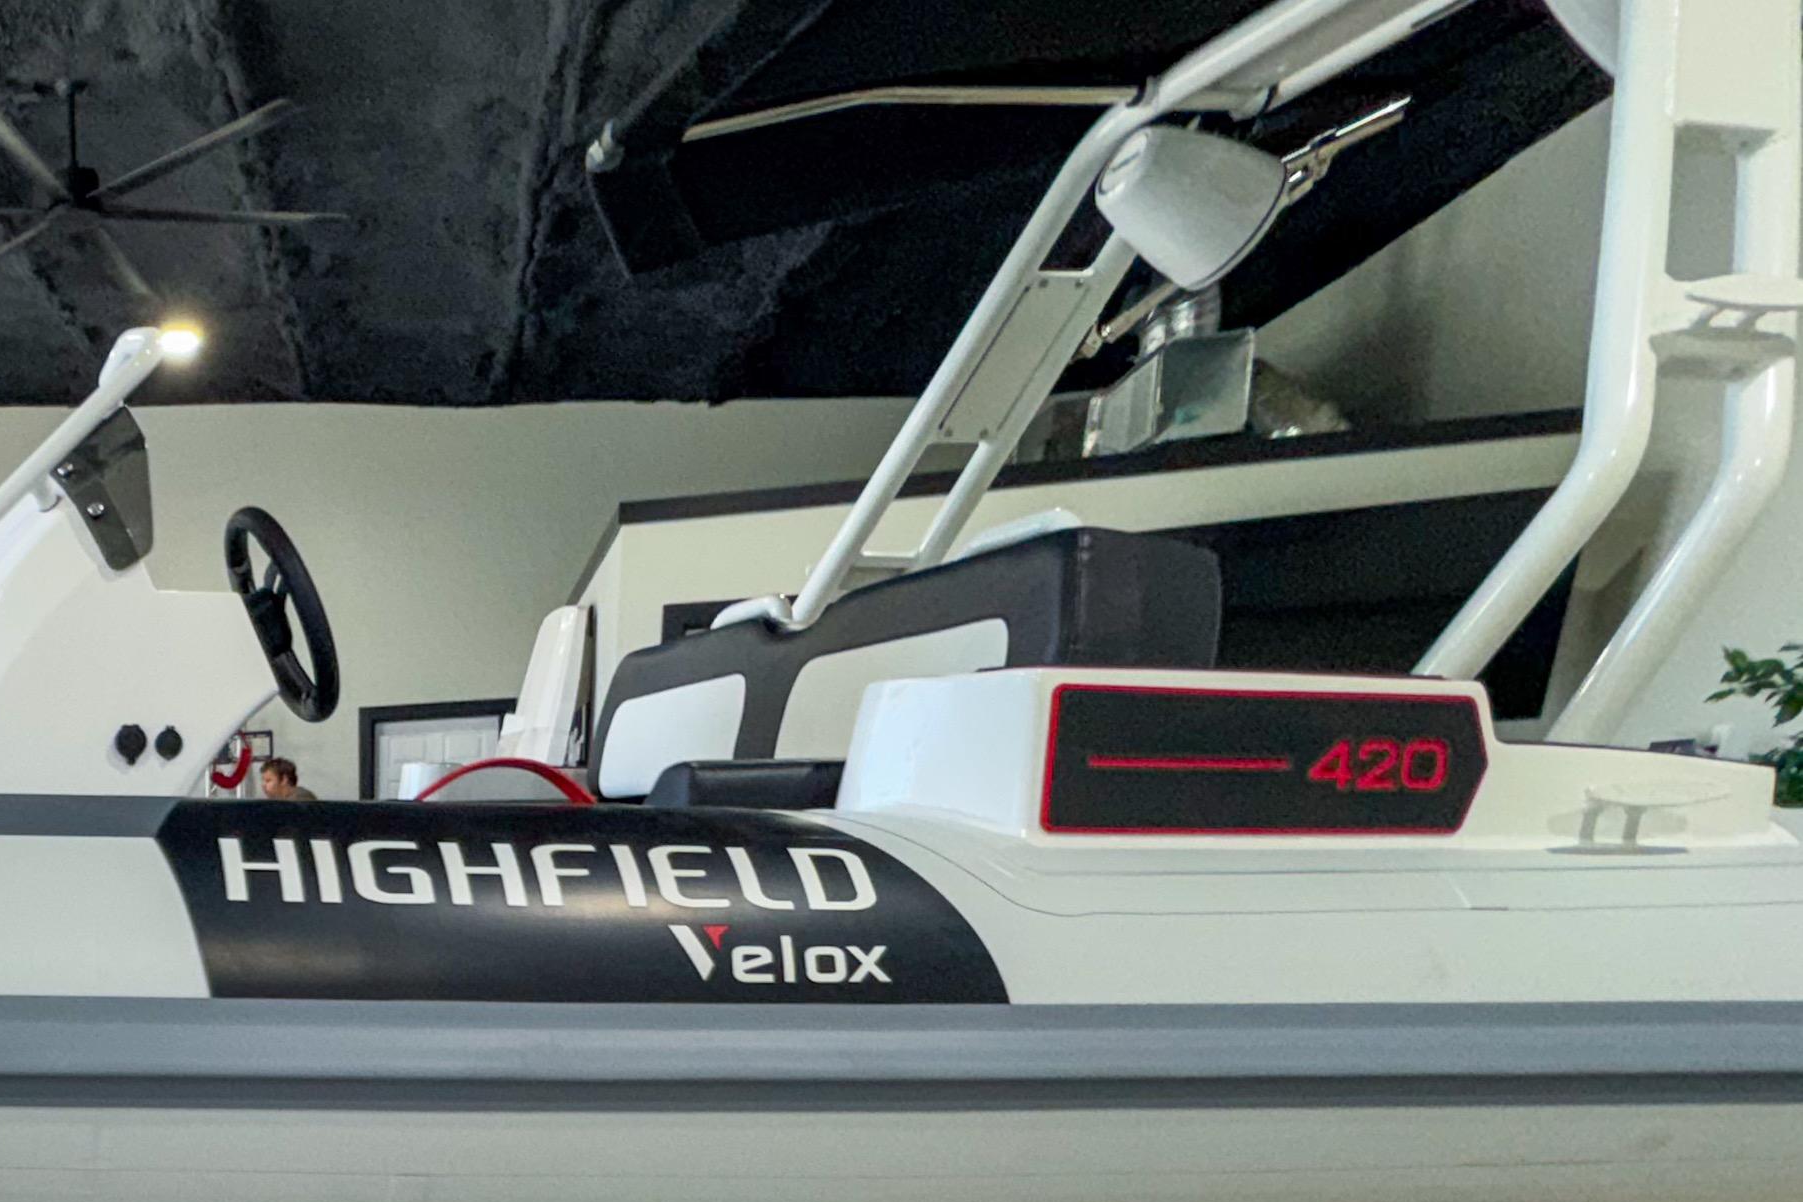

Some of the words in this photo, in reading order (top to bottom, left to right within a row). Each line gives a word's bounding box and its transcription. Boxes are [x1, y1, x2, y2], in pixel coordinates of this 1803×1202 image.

[1308, 738, 1449, 791] 420
[218, 837, 878, 911] HIGHFIELD
[667, 924, 892, 984] Velox
